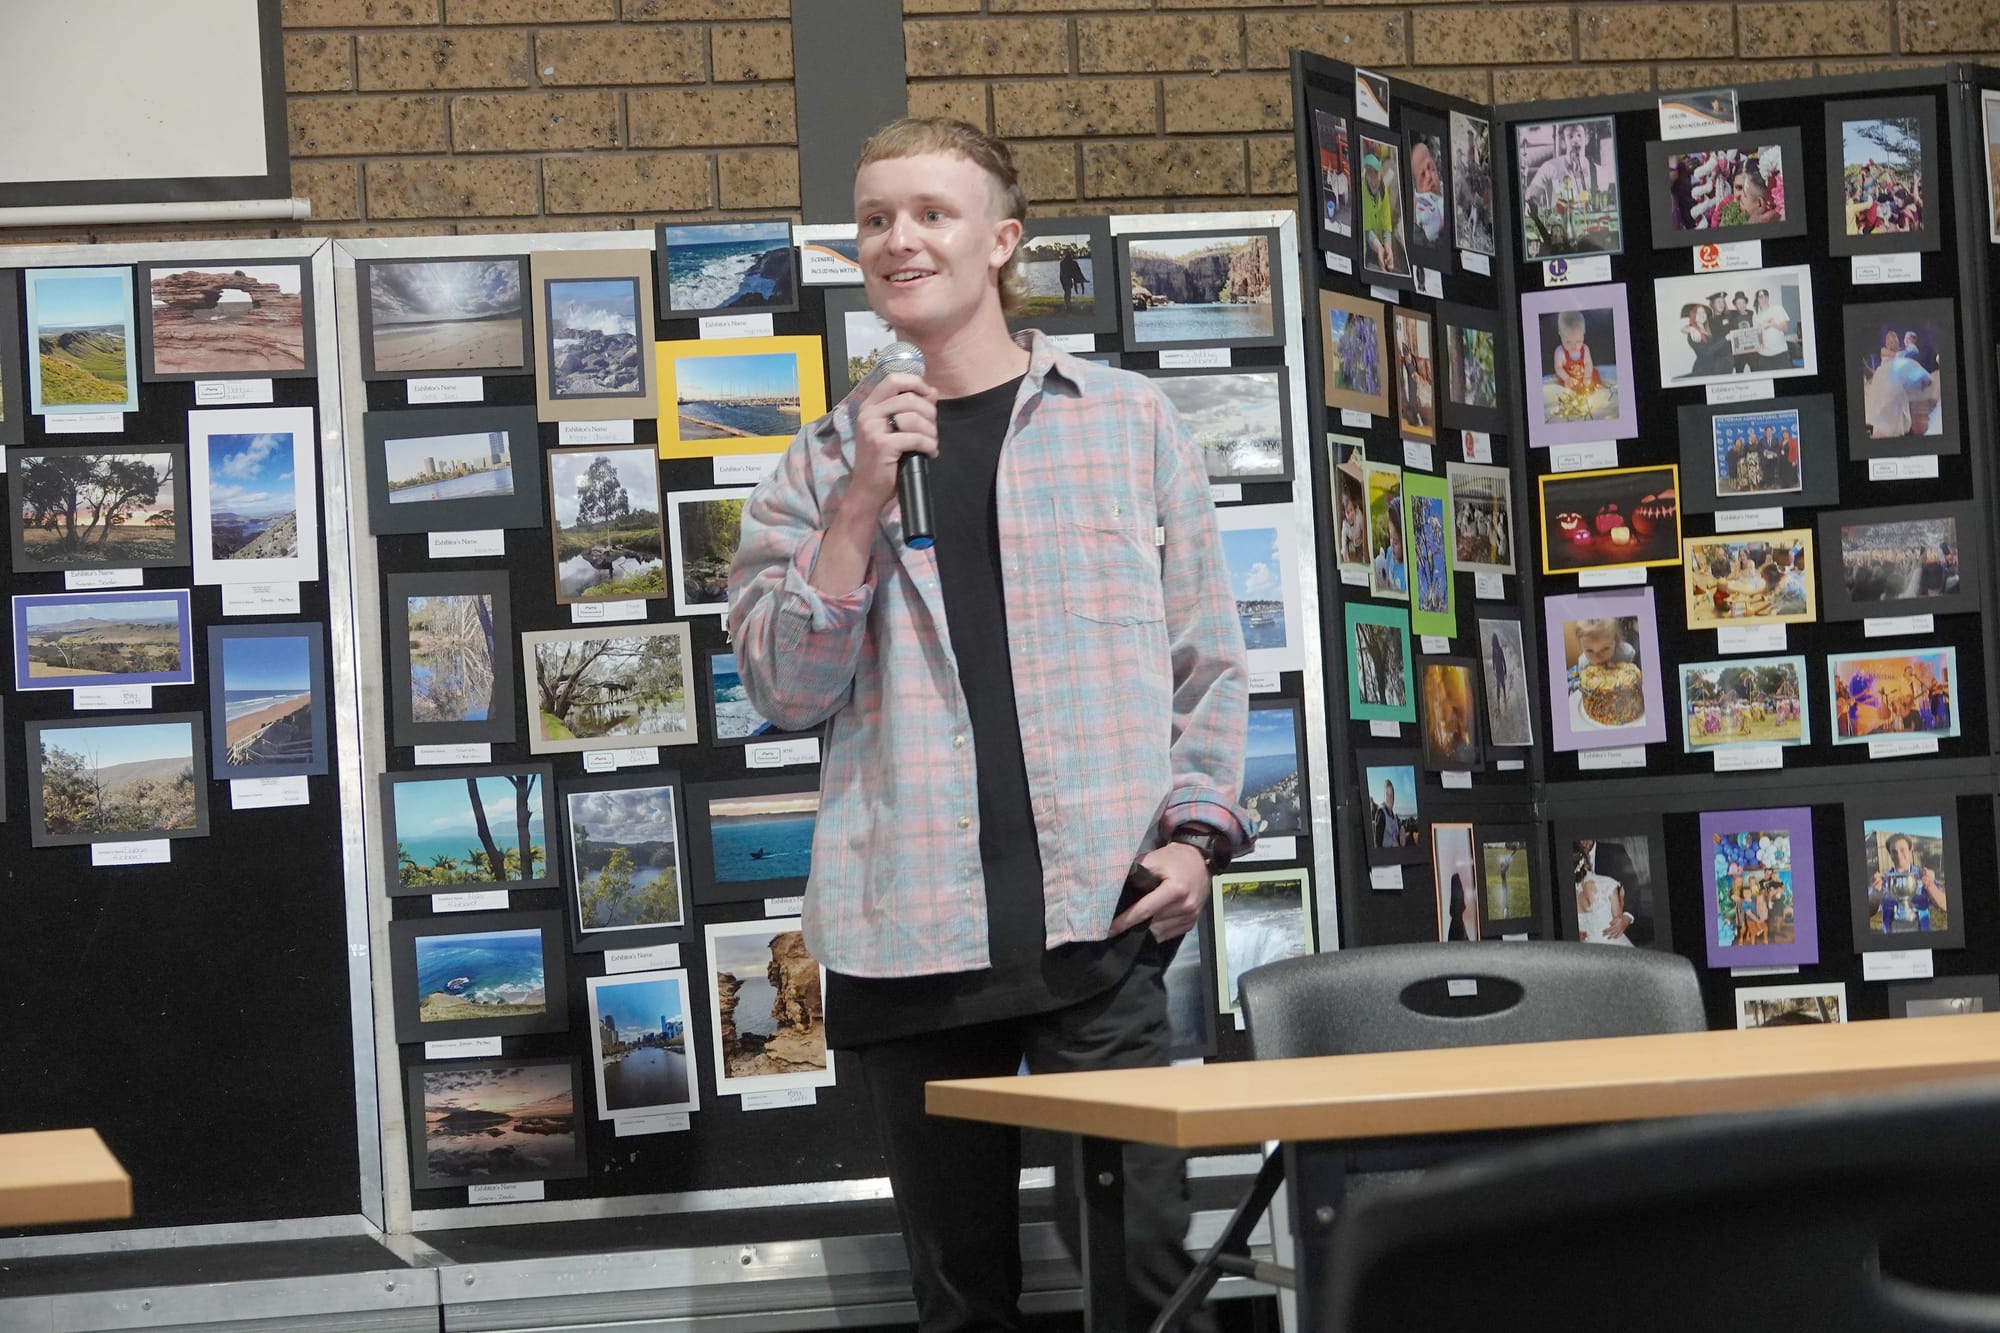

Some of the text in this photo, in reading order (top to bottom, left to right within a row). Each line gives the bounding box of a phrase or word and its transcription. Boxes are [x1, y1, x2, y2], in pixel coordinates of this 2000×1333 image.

[591, 425, 607, 433] Name
[637, 951, 653, 959] Name
[500, 1182, 517, 1191] Name
